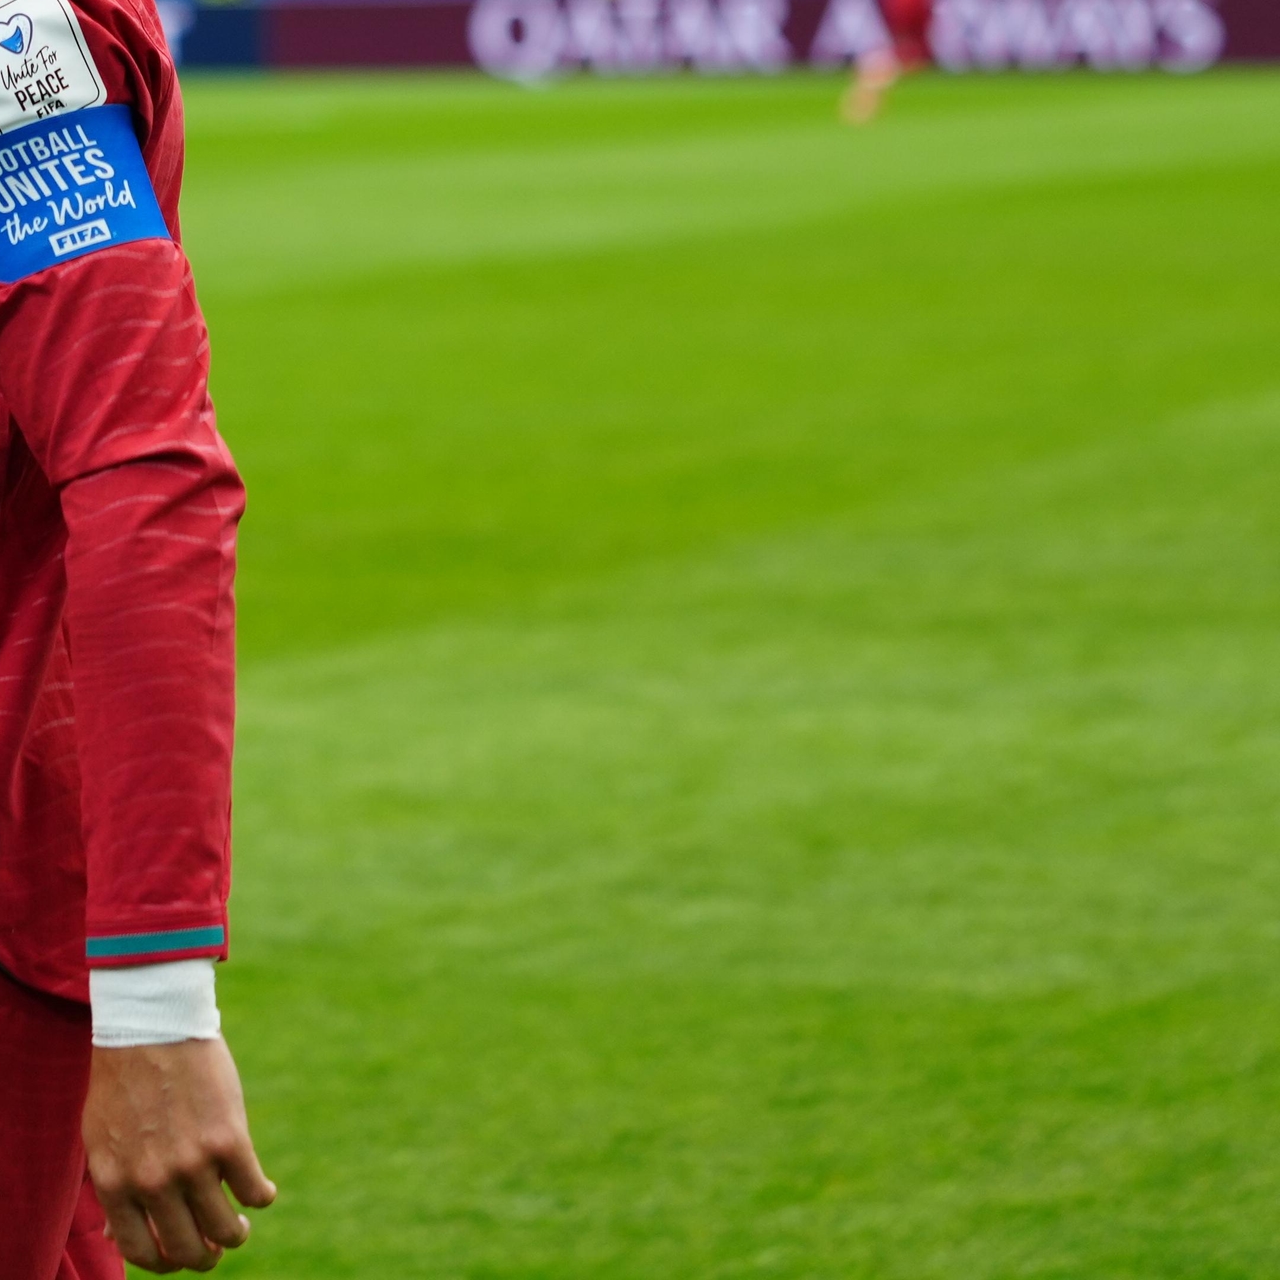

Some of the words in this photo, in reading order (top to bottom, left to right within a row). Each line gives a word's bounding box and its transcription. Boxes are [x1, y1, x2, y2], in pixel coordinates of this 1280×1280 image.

[0, 58, 39, 90] Unite
[36, 45, 57, 71] For
[14, 67, 69, 112] PEACE
[36, 99, 65, 119] FIFA
[0, 212, 49, 246] the
[47, 179, 137, 226] World
[55, 224, 107, 251] FIFA
